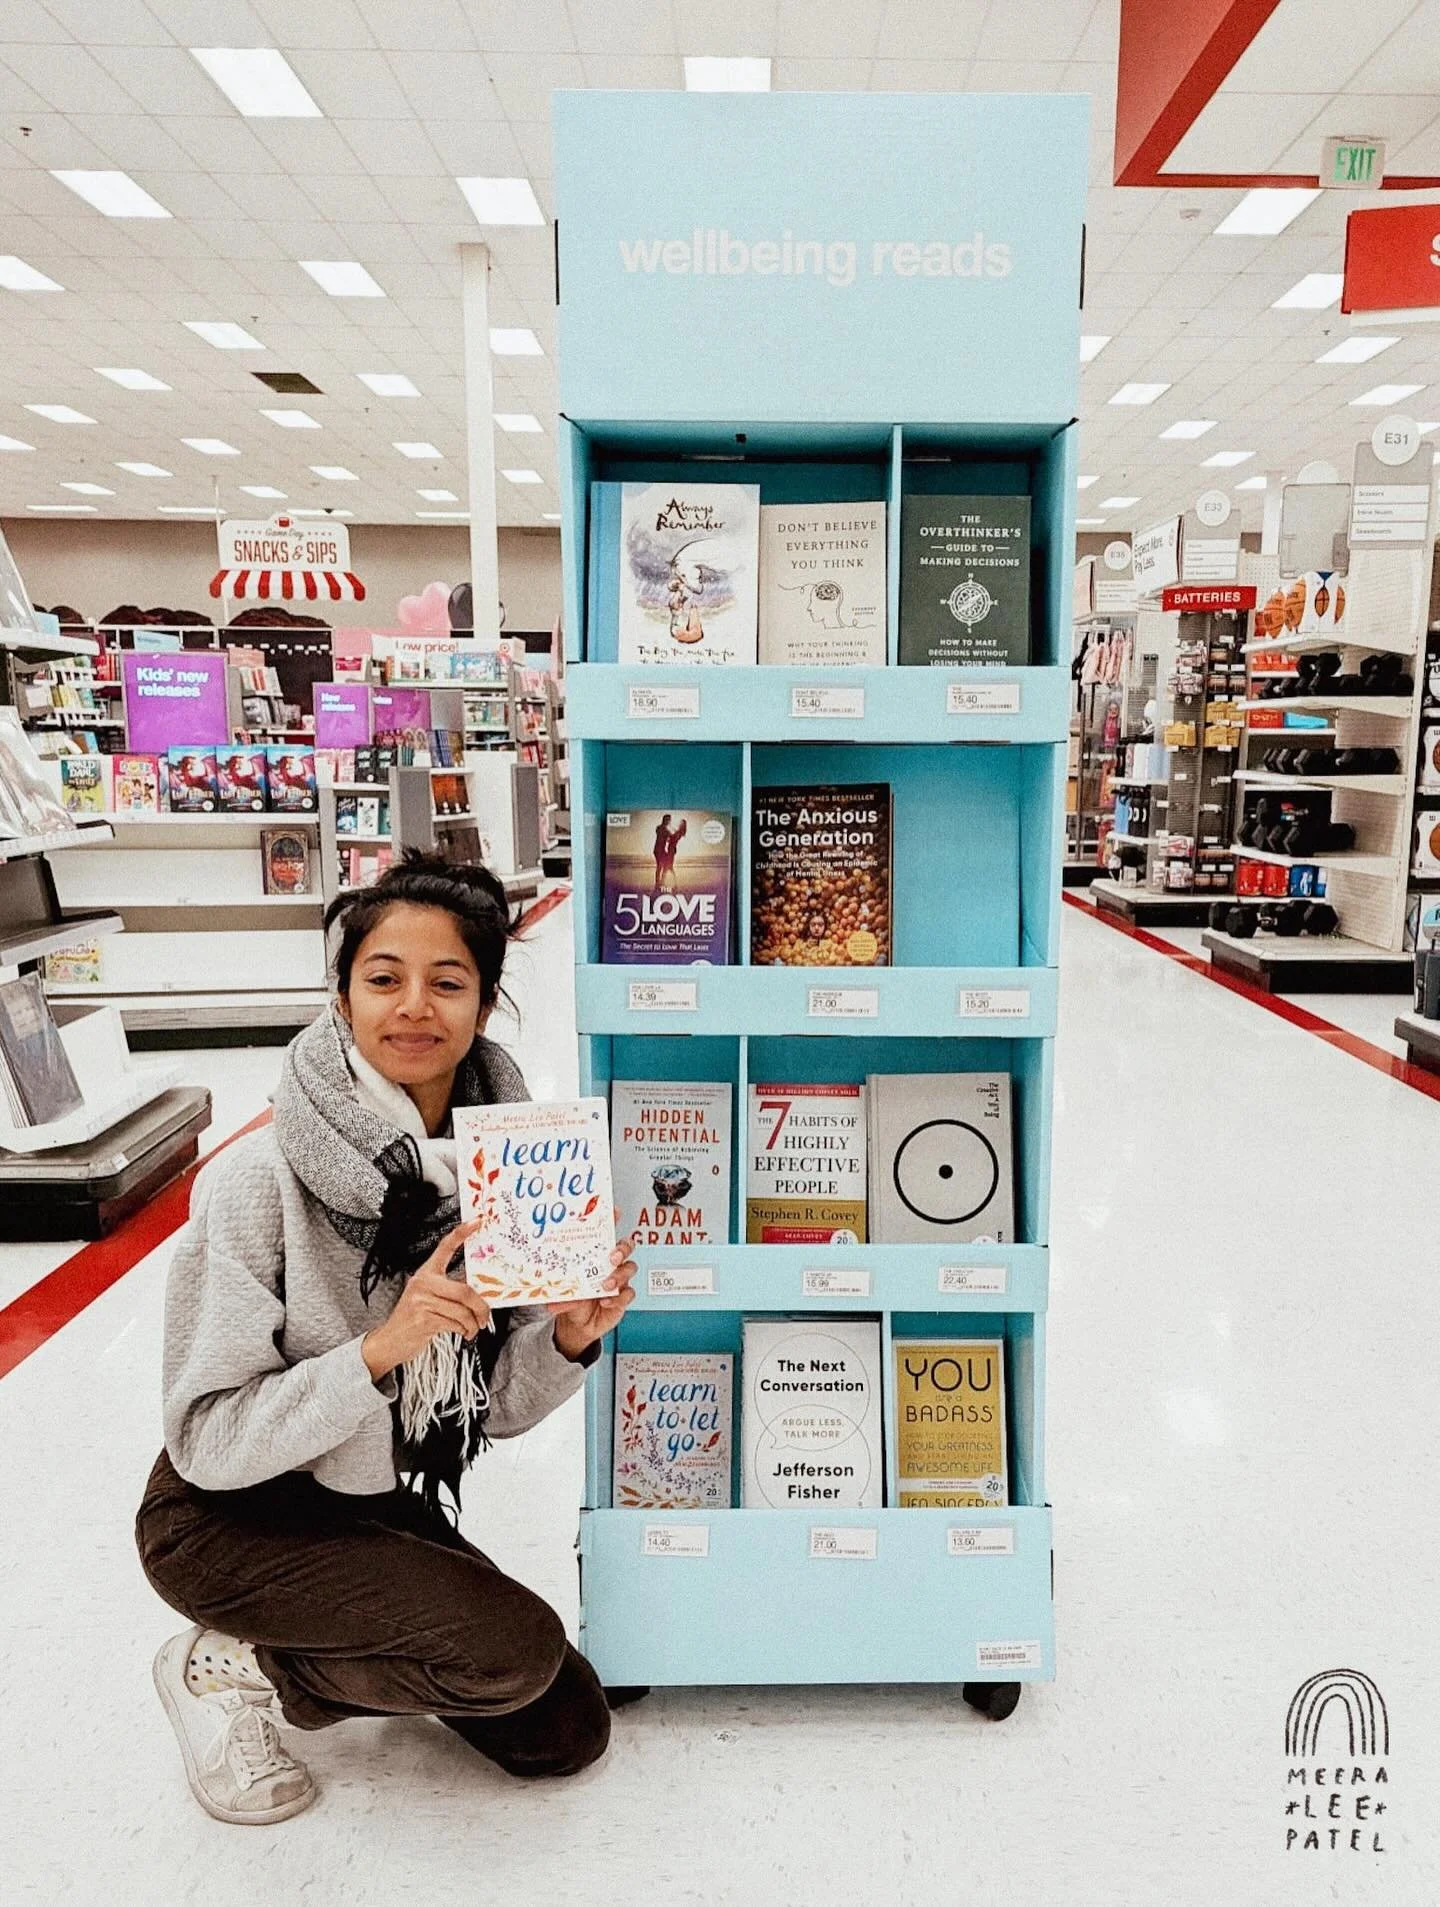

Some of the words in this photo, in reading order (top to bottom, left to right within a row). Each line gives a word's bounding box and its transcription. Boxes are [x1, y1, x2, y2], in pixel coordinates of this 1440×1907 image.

[1334, 145, 1377, 181] EXIT
[618, 228, 856, 285] wellbeing
[870, 231, 1014, 278] reads
[1384, 432, 1408, 445] E31
[665, 498, 713, 520] Always
[656, 513, 726, 531] Remember
[960, 515, 981, 523] THE
[264, 528, 288, 537] Game
[777, 522, 819, 533] DON'T
[824, 519, 878, 532] BELIEVE
[919, 527, 1021, 537] OVERTHINKER'S
[786, 539, 869, 551] EVERYTHING
[946, 544, 977, 552] GUIDE
[980, 544, 995, 552] TO
[234, 540, 289, 563] SNACKS
[292, 545, 303, 560] &
[306, 542, 337, 564] SIPS
[791, 559, 817, 570] YOU
[822, 558, 864, 568] THINK
[920, 558, 961, 566] MAKING
[965, 558, 1020, 566] DECISIONS
[1174, 592, 1241, 604] BATTERIES
[425, 641, 459, 653] price!
[975, 639, 997, 647] MAKE
[928, 649, 970, 657] DECISIONS
[136, 667, 173, 682] Kids'
[176, 671, 209, 683] new
[138, 683, 201, 697] releases
[633, 697, 658, 707] 18.90
[796, 698, 821, 708] 15.40
[953, 695, 977, 704] 15.40
[609, 815, 628, 825] LOVE
[755, 809, 791, 826] The
[797, 807, 878, 825] Anxious
[759, 829, 874, 848] Generation
[660, 886, 672, 894] THE
[613, 893, 641, 935] 5
[642, 894, 716, 922] LOVE
[641, 924, 715, 936] LANGUAGES
[812, 999, 837, 1008] 21.00
[641, 1109, 704, 1124] HIDDEN
[759, 1101, 792, 1150] 7
[789, 1116, 838, 1128] HABITS
[841, 1116, 858, 1127] OF
[624, 1127, 720, 1143] POTENTIAL
[784, 1136, 850, 1149] HIGHLY
[502, 1137, 591, 1167] learn
[754, 1157, 860, 1173] EFFECTIVE
[515, 1170, 544, 1199] to
[557, 1164, 595, 1197] let
[775, 1180, 838, 1194] PEOPLE
[531, 1201, 567, 1239] go
[638, 1208, 702, 1227] ADAM
[751, 1207, 800, 1223] Stephen
[805, 1208, 819, 1220] R.
[821, 1208, 859, 1225] Covey
[585, 1266, 599, 1279] 20
[943, 1276, 967, 1285] 22.40
[777, 1360, 805, 1372] The
[810, 1360, 846, 1372] Next
[905, 1358, 992, 1392] YOU
[648, 1379, 718, 1402] learn
[760, 1379, 864, 1392] Conversation
[935, 1394, 953, 1402] are
[655, 1405, 679, 1430] to
[689, 1405, 720, 1431] let
[906, 1405, 993, 1422] BADASS
[782, 1418, 815, 1426] ARGUE
[785, 1430, 808, 1438] TALK
[812, 1430, 840, 1438] MORE
[667, 1432, 695, 1463] go
[906, 1441, 934, 1450] YOUR
[938, 1441, 993, 1450] GREATNESS
[773, 1462, 854, 1477] Jefferson
[907, 1462, 970, 1473] AWESOME
[974, 1462, 993, 1472] LIFE
[706, 1487, 717, 1496] 20
[788, 1485, 840, 1499] Fisher
[986, 1480, 999, 1492] 20
[647, 1538, 671, 1547] 14.40
[813, 1540, 837, 1549] 21.00
